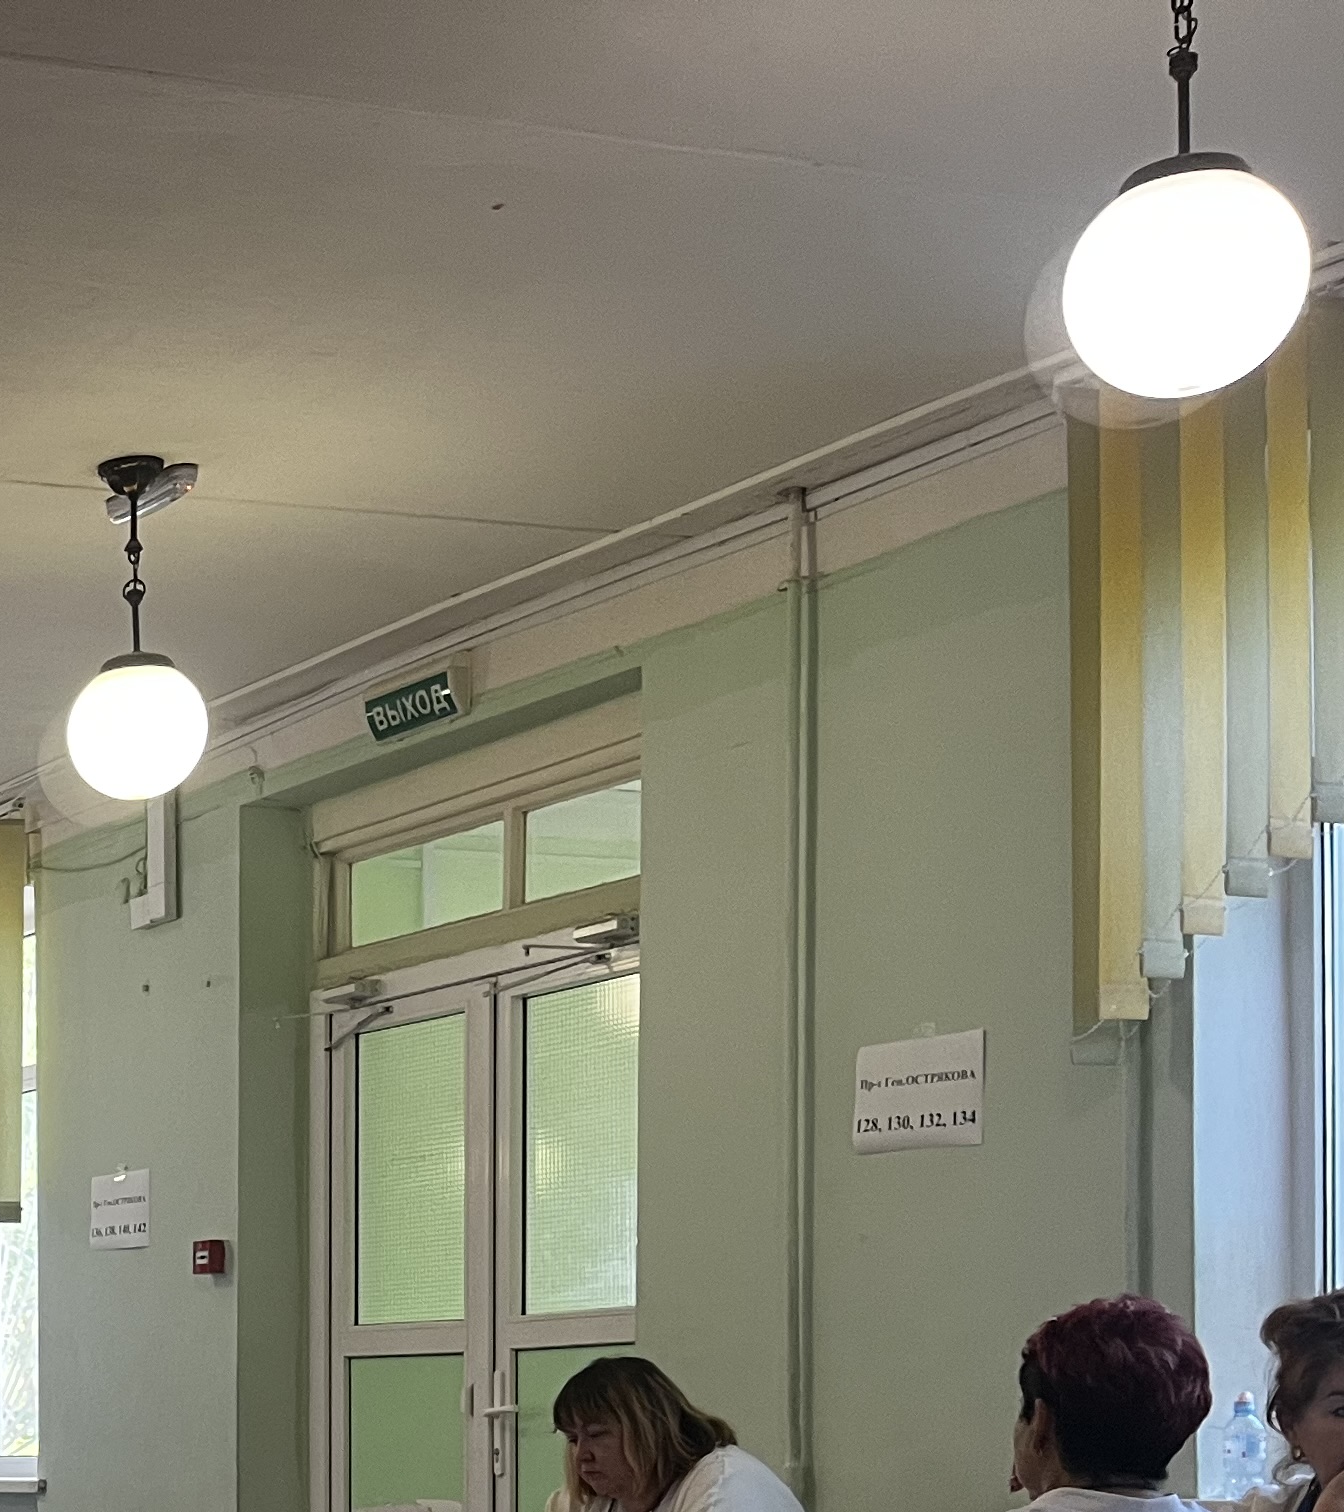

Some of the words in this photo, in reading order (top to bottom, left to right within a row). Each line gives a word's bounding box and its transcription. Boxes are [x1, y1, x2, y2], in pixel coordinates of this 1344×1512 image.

[371, 683, 450, 731] ВЫХОД
[857, 1117, 882, 1133] 128,
[888, 1114, 914, 1131] 130,
[919, 1112, 947, 1128] 132,
[952, 1109, 976, 1126] 134
